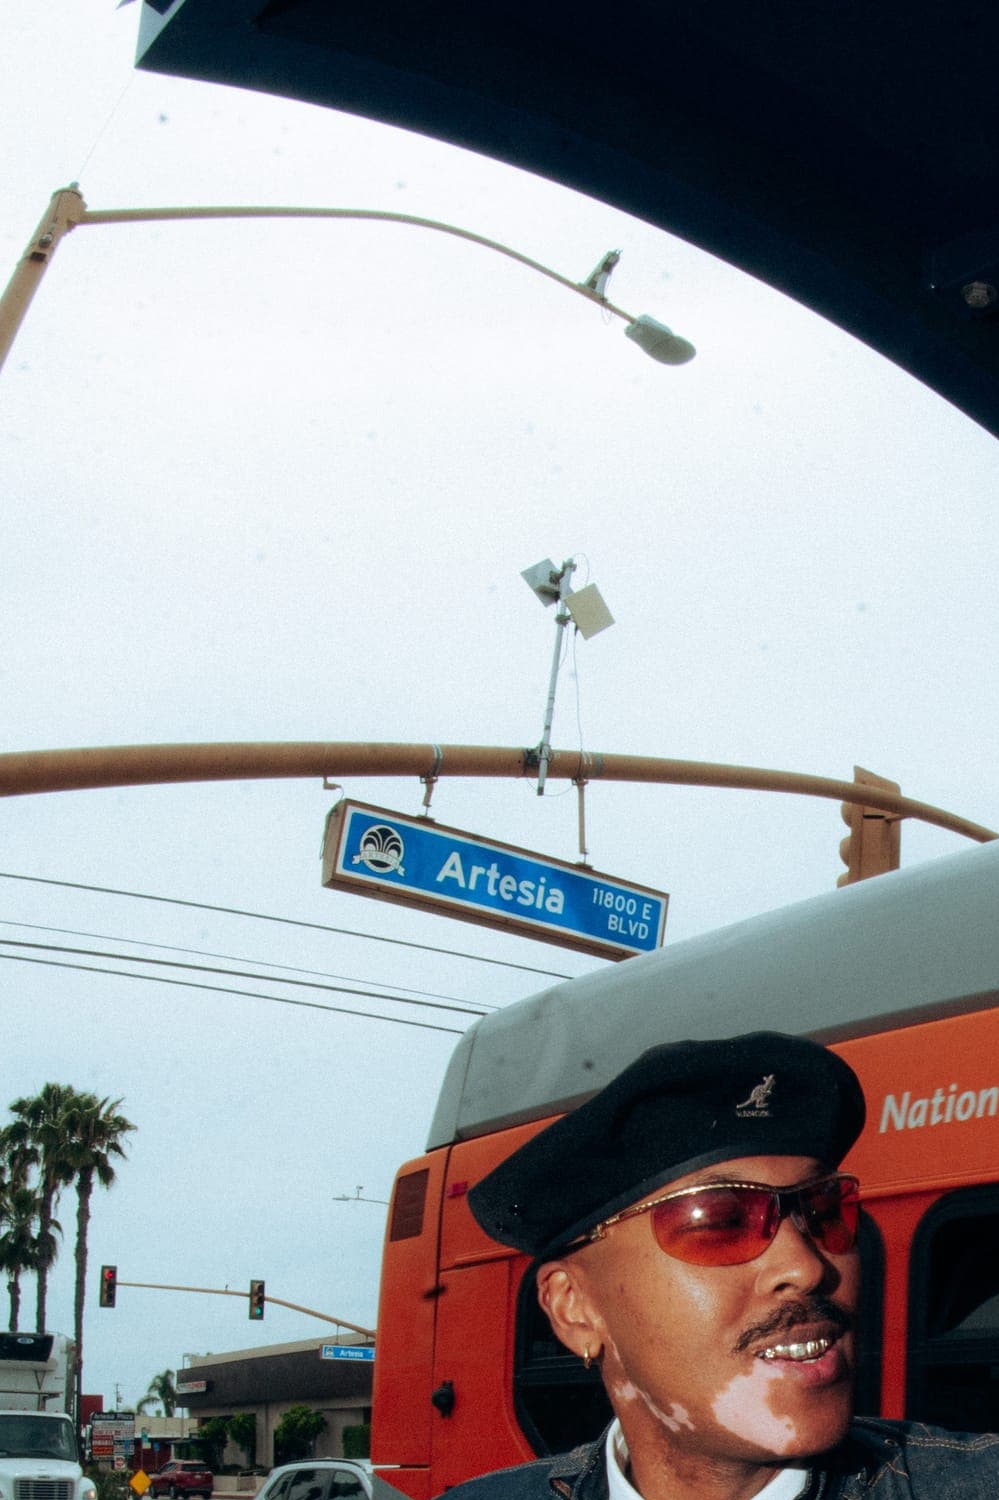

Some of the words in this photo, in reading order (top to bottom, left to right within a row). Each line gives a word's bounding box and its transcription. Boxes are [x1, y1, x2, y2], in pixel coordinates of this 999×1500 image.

[436, 852, 565, 914] Artesia
[591, 887, 637, 916] 11800
[642, 904, 652, 920] E
[608, 916, 649, 940] BLVD
